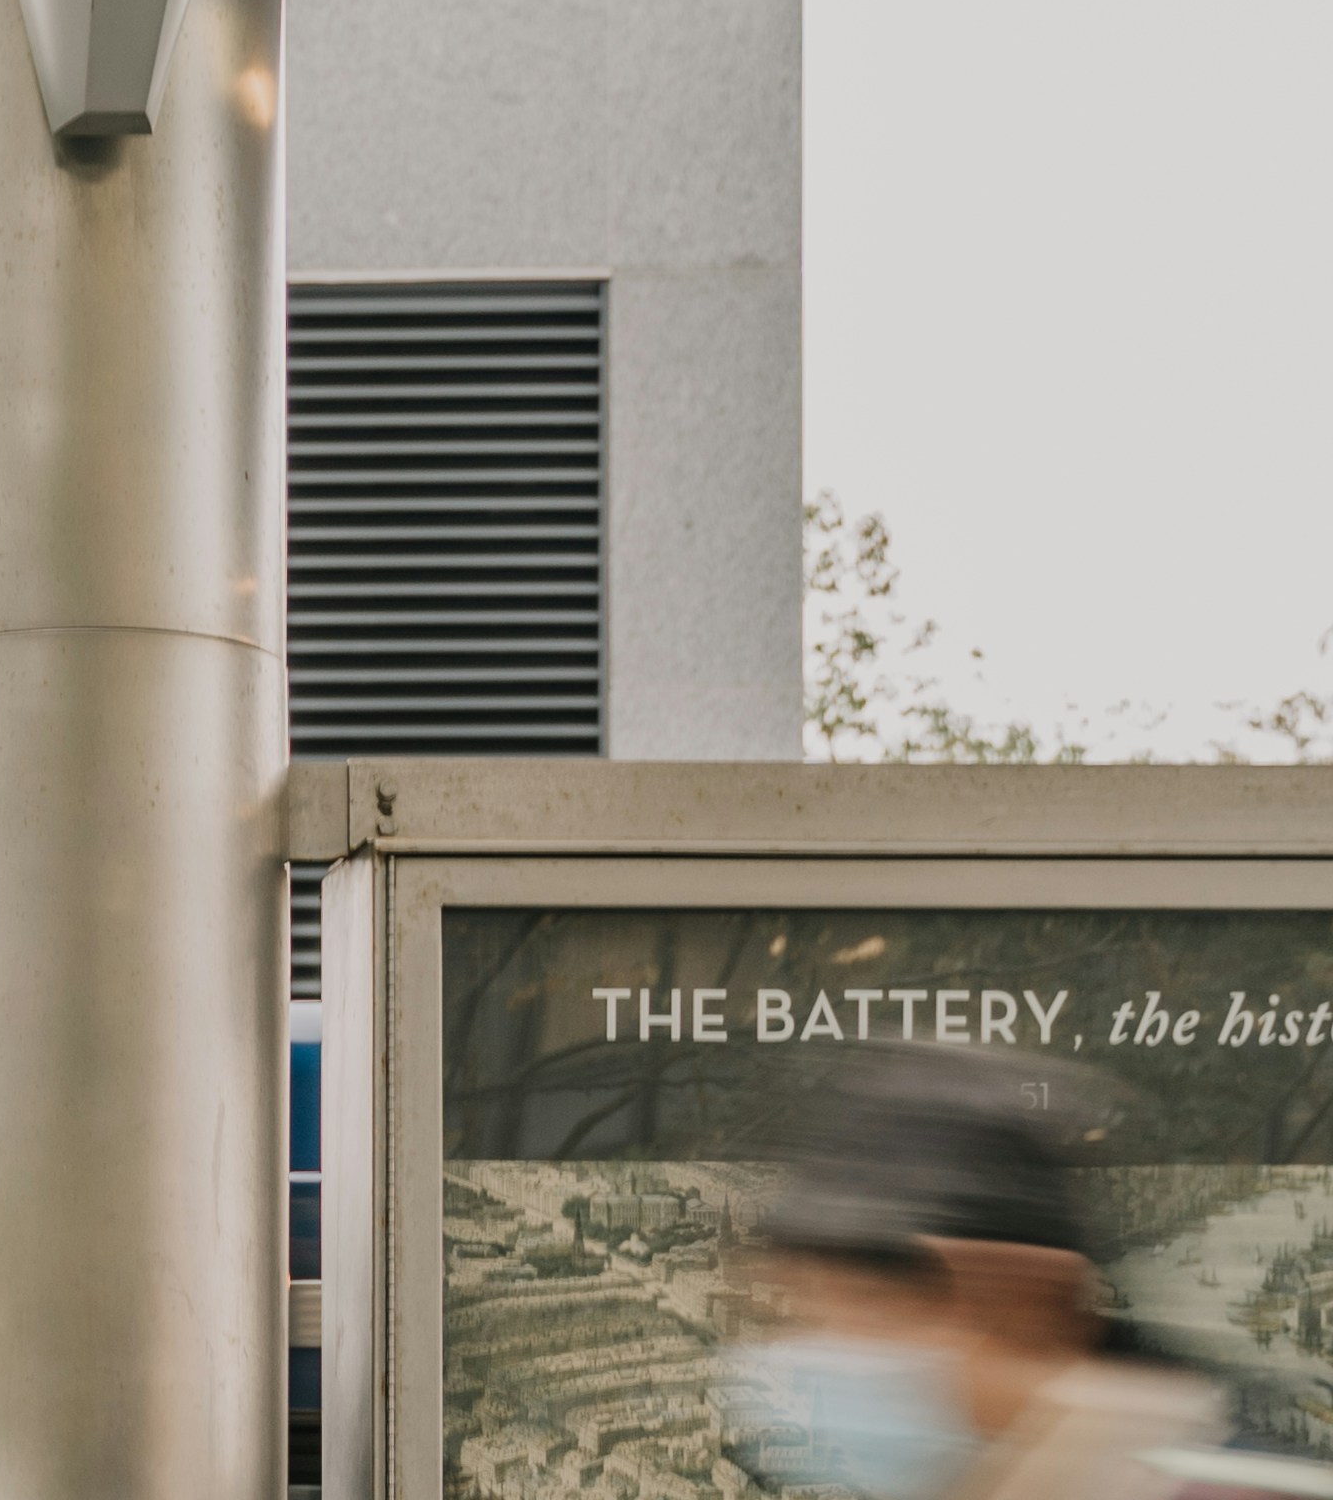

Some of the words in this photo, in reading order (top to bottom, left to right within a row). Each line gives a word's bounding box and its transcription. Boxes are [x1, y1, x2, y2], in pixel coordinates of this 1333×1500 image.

[592, 987, 728, 1043] THE
[757, 988, 1082, 1052] BATTERY,
[1109, 990, 1201, 1046] the
[1217, 991, 1333, 1047] hist
